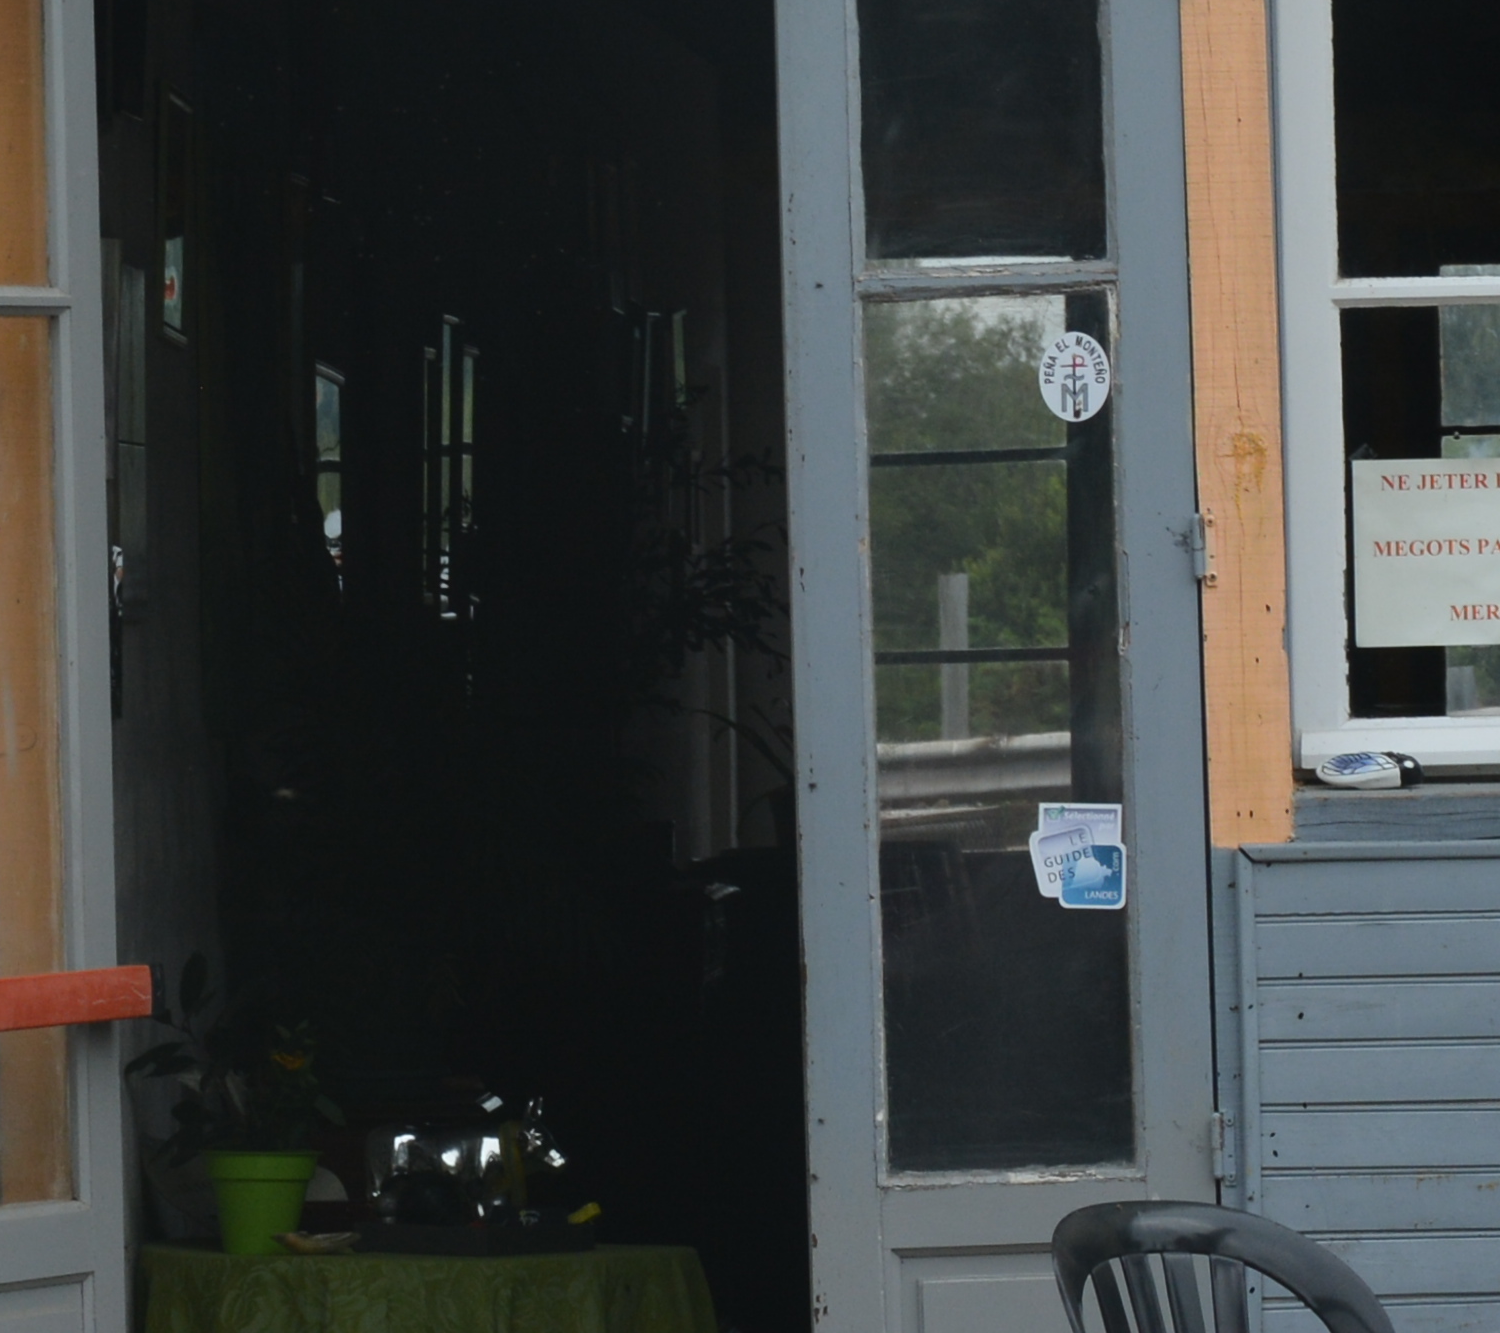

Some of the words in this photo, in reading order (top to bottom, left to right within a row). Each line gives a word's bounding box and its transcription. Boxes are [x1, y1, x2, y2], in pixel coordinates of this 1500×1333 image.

[1043, 355, 1059, 385] PEÑA
[1055, 338, 1070, 353] EL
[1075, 335, 1108, 384] MONTEÑO
[1380, 474, 1411, 491] NE
[1417, 472, 1490, 491] JETER
[1373, 539, 1471, 557] MEGOTS
[1069, 832, 1088, 846] LE
[1044, 847, 1092, 868] GUIDE
[1047, 867, 1076, 883] DES
[1084, 890, 1119, 900] LANDES
